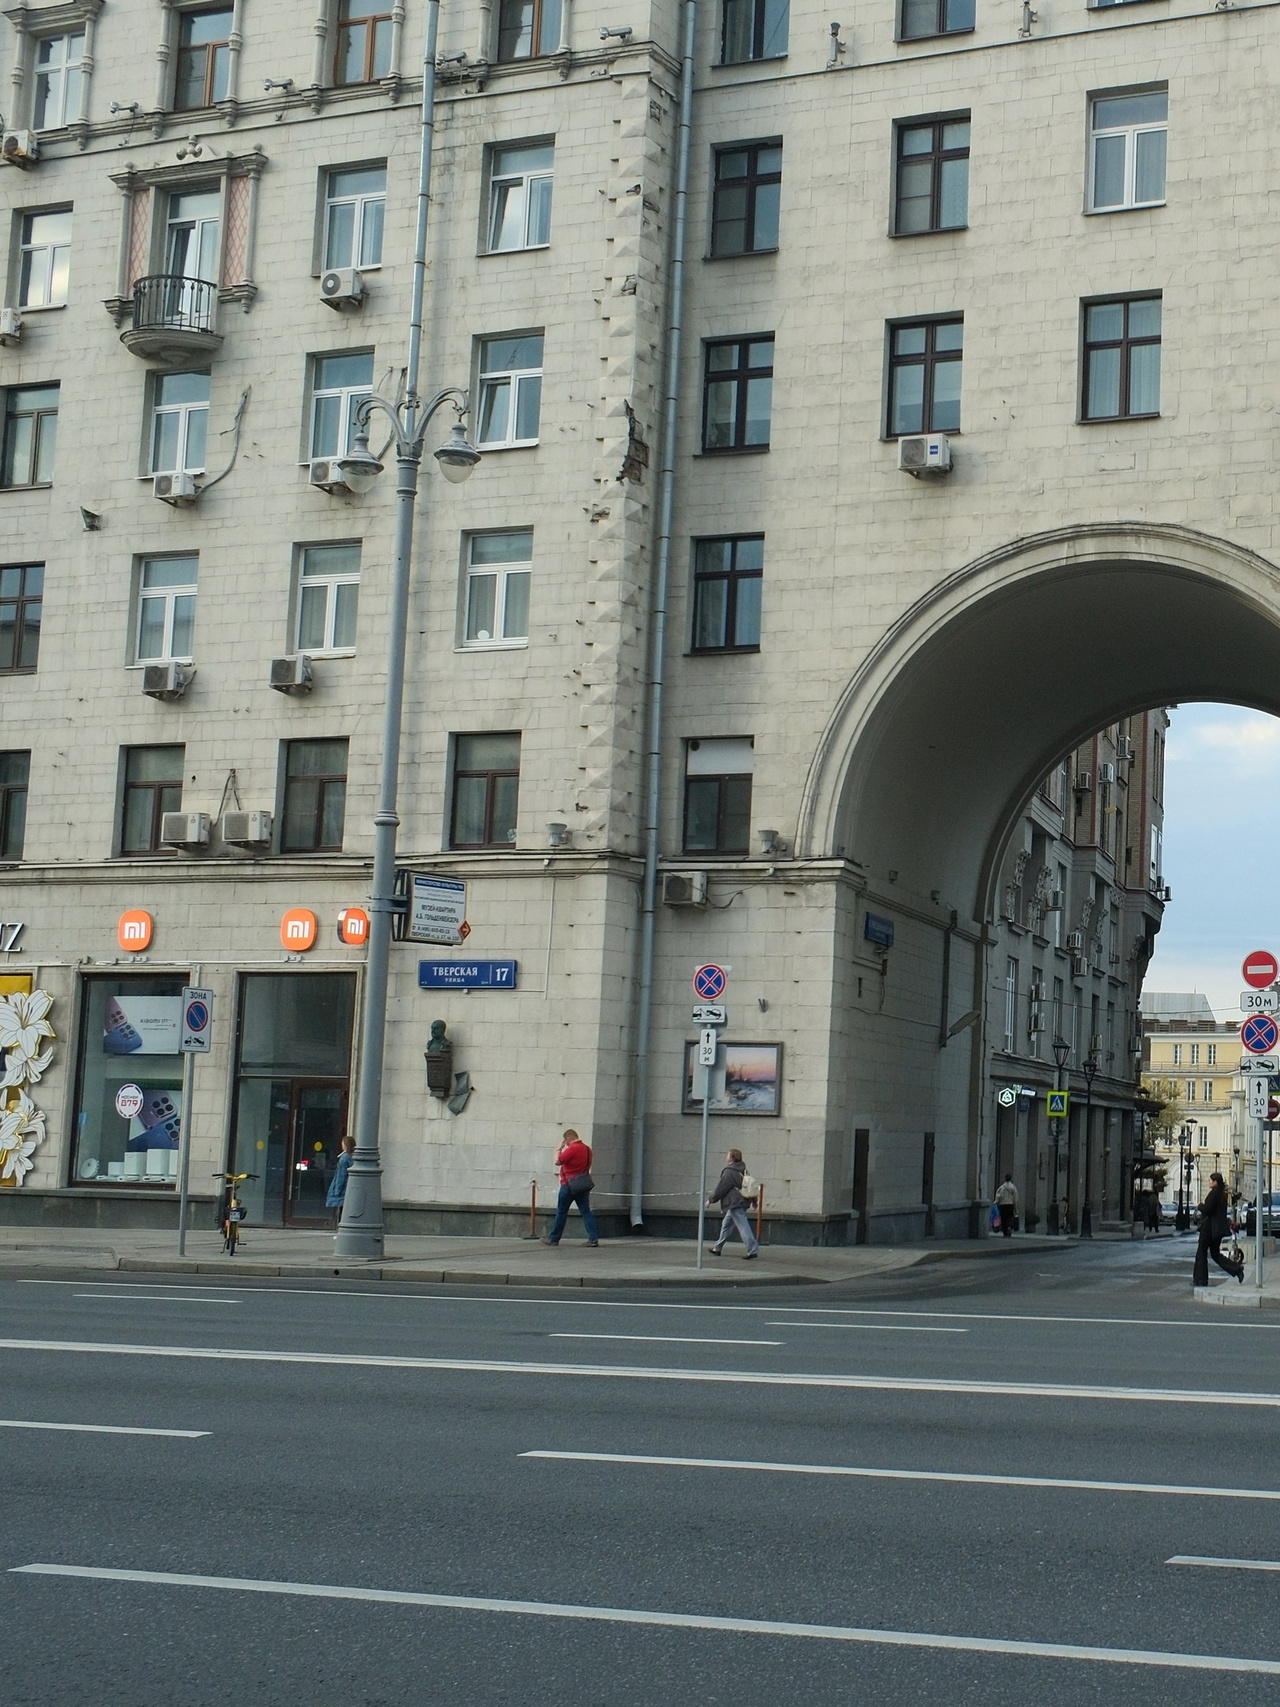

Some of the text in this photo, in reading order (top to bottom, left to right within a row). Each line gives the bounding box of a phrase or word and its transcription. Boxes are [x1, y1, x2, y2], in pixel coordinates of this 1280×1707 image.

[0, 922, 24, 952] Z
[432, 966, 509, 981] ТВЕРСКАЯ 17
[190, 991, 207, 1000] ЗОНА
[702, 1046, 712, 1055] 30
[1253, 1097, 1265, 1107] 30
